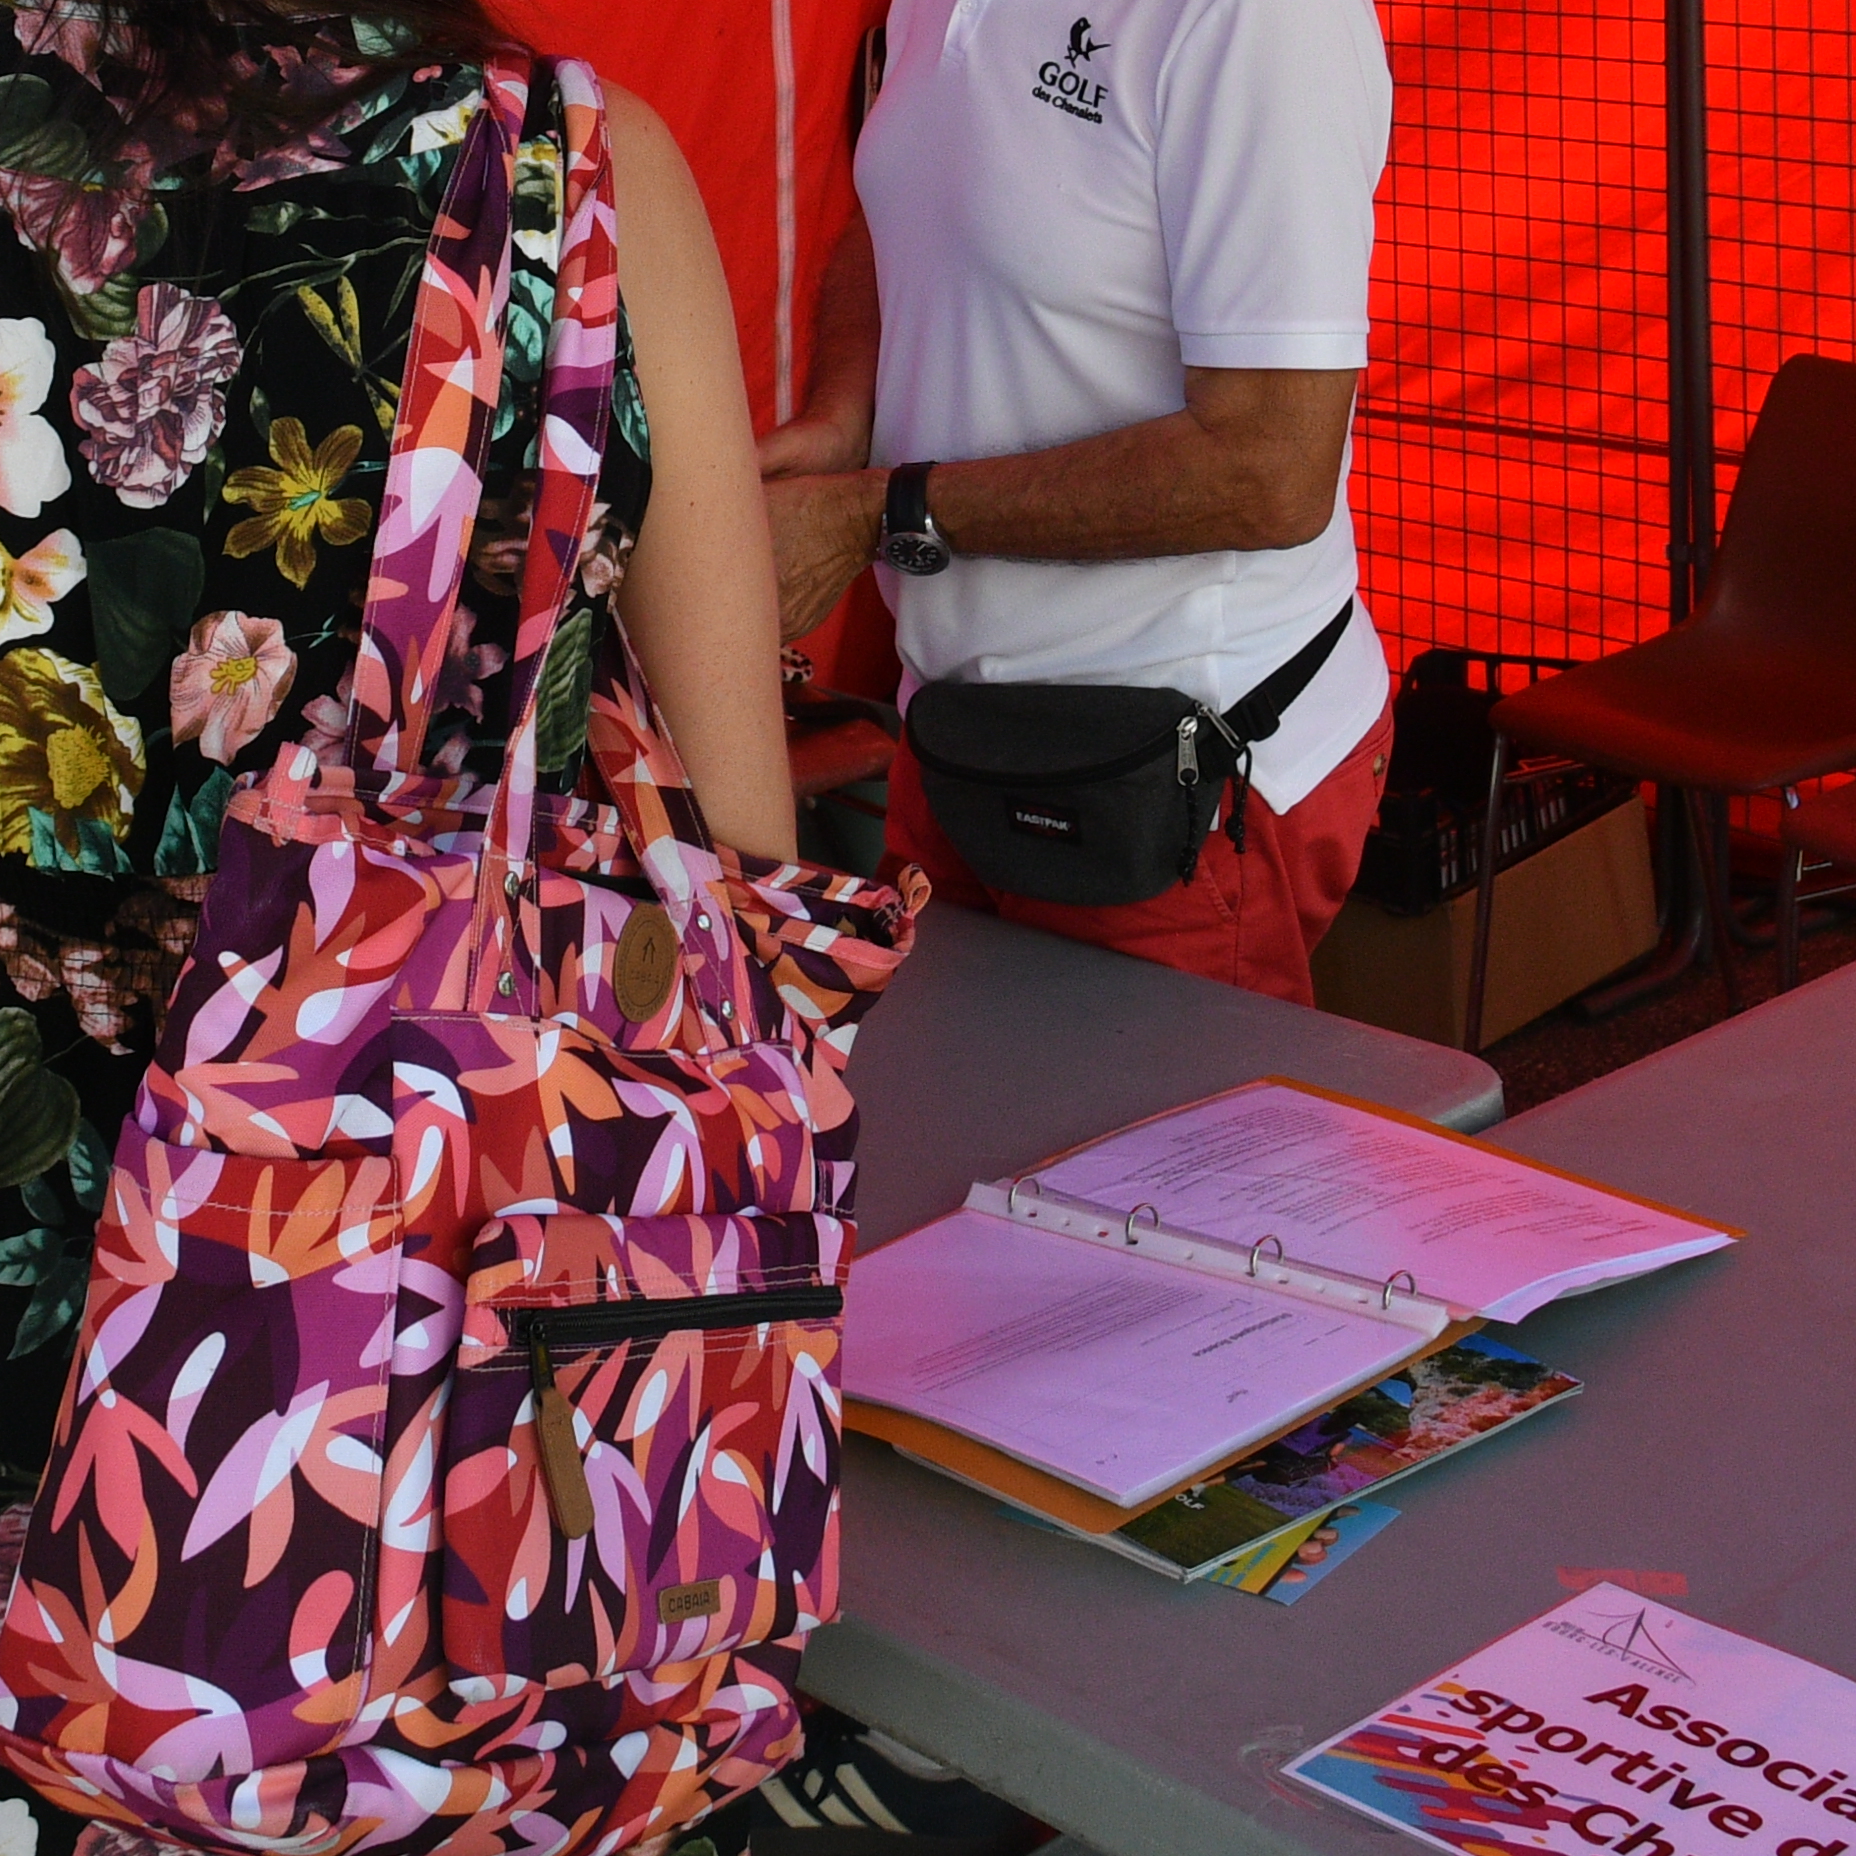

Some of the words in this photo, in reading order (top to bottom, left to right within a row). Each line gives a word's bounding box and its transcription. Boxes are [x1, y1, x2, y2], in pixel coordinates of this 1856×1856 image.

[1039, 61, 1109, 108] GOLF
[1032, 85, 1051, 103] des
[1052, 96, 1102, 124] Chanalets
[1015, 811, 1069, 832] EASTPAK
[1174, 1494, 1206, 1510] OLF
[668, 1591, 710, 1613] CABAIA
[1450, 1687, 1764, 1839] sportive
[1418, 1741, 1560, 1811] des
[1569, 1804, 1676, 1856] Ch
